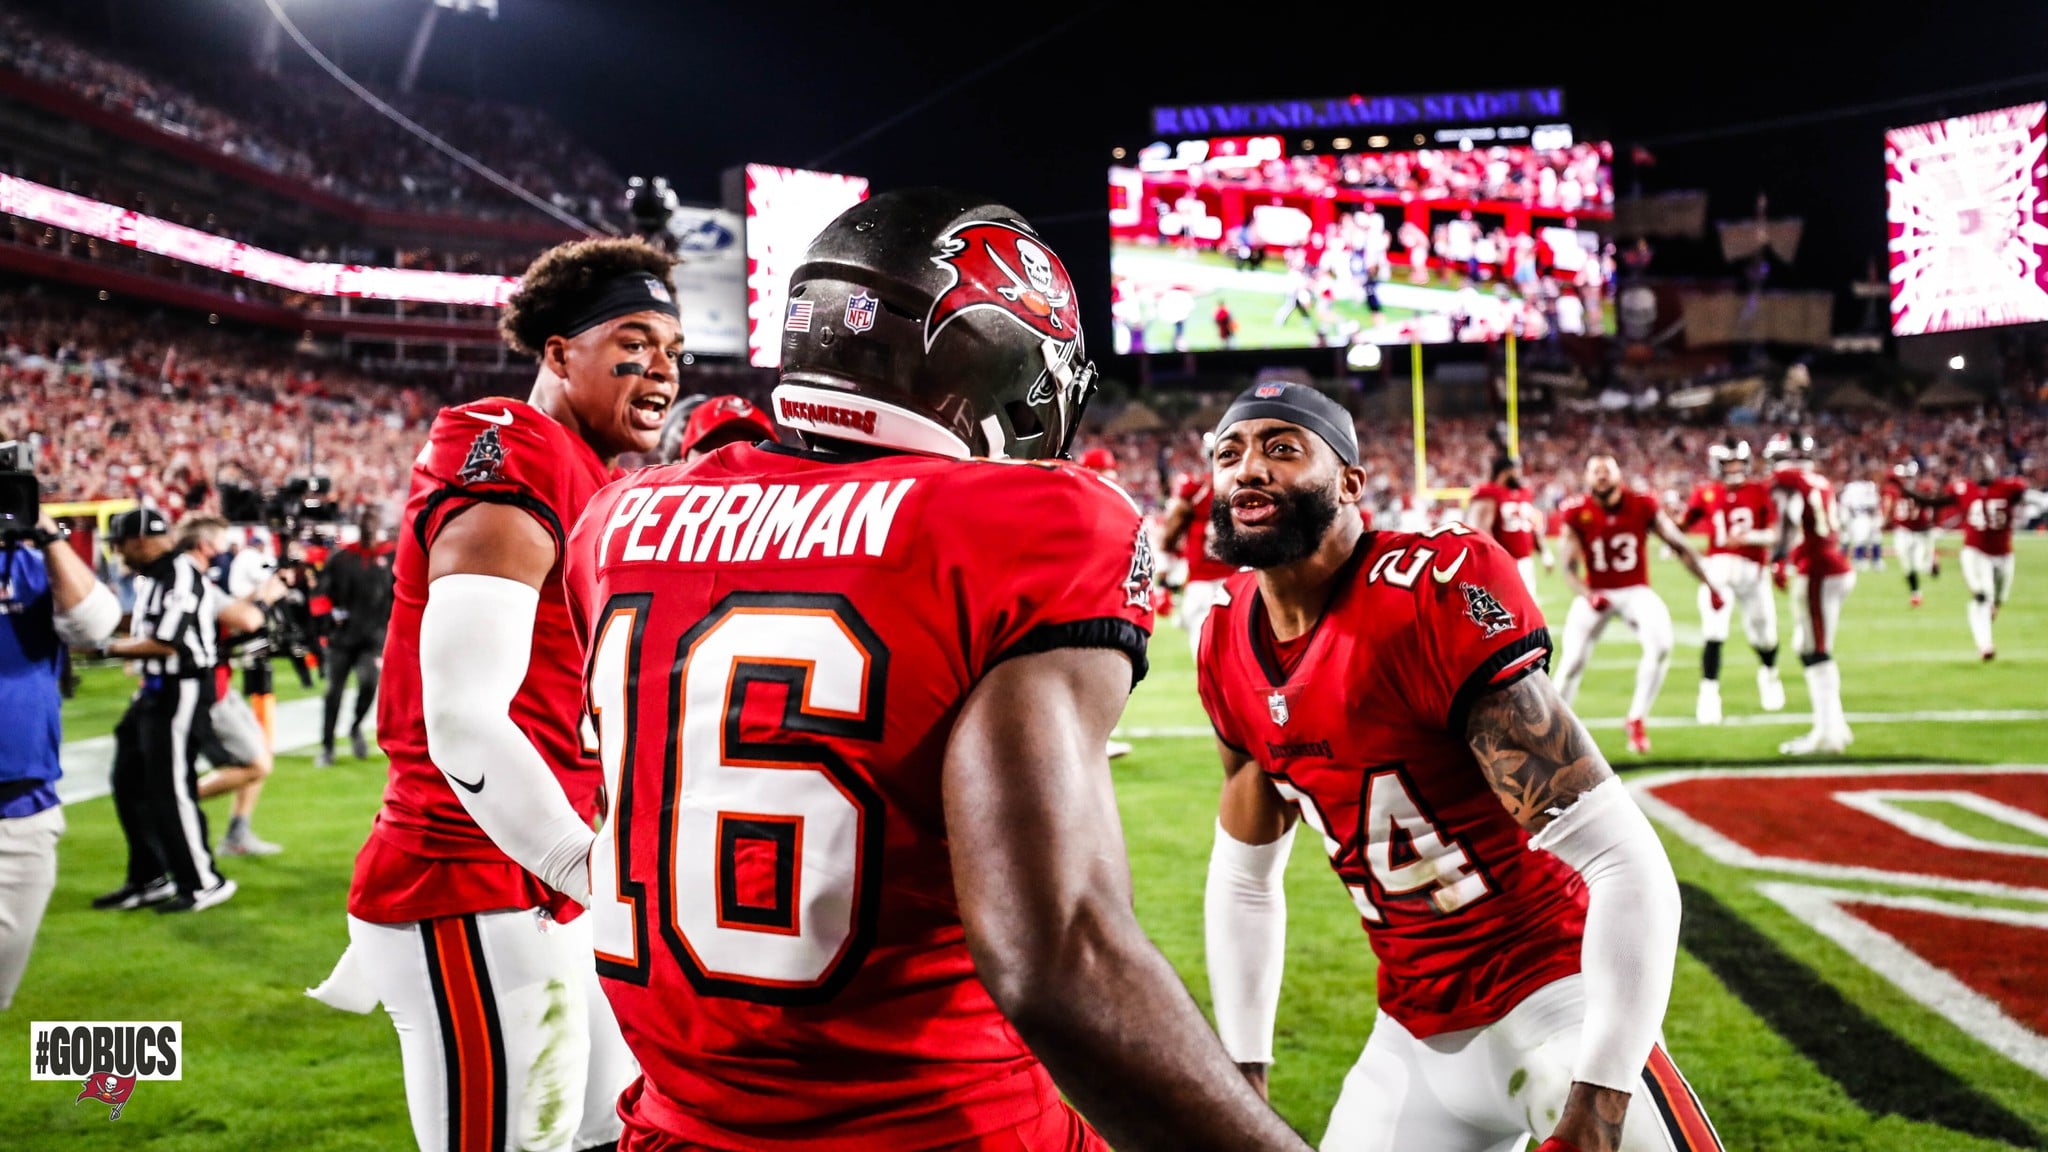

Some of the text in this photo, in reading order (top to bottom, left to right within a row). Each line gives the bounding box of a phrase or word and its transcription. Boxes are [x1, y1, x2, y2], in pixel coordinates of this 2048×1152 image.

[848, 309, 870, 327] NFL
[779, 397, 877, 434] BUCCANEERS
[599, 478, 916, 567] PERRIMAN
[1591, 532, 1638, 572] 13
[588, 591, 891, 1006] 16
